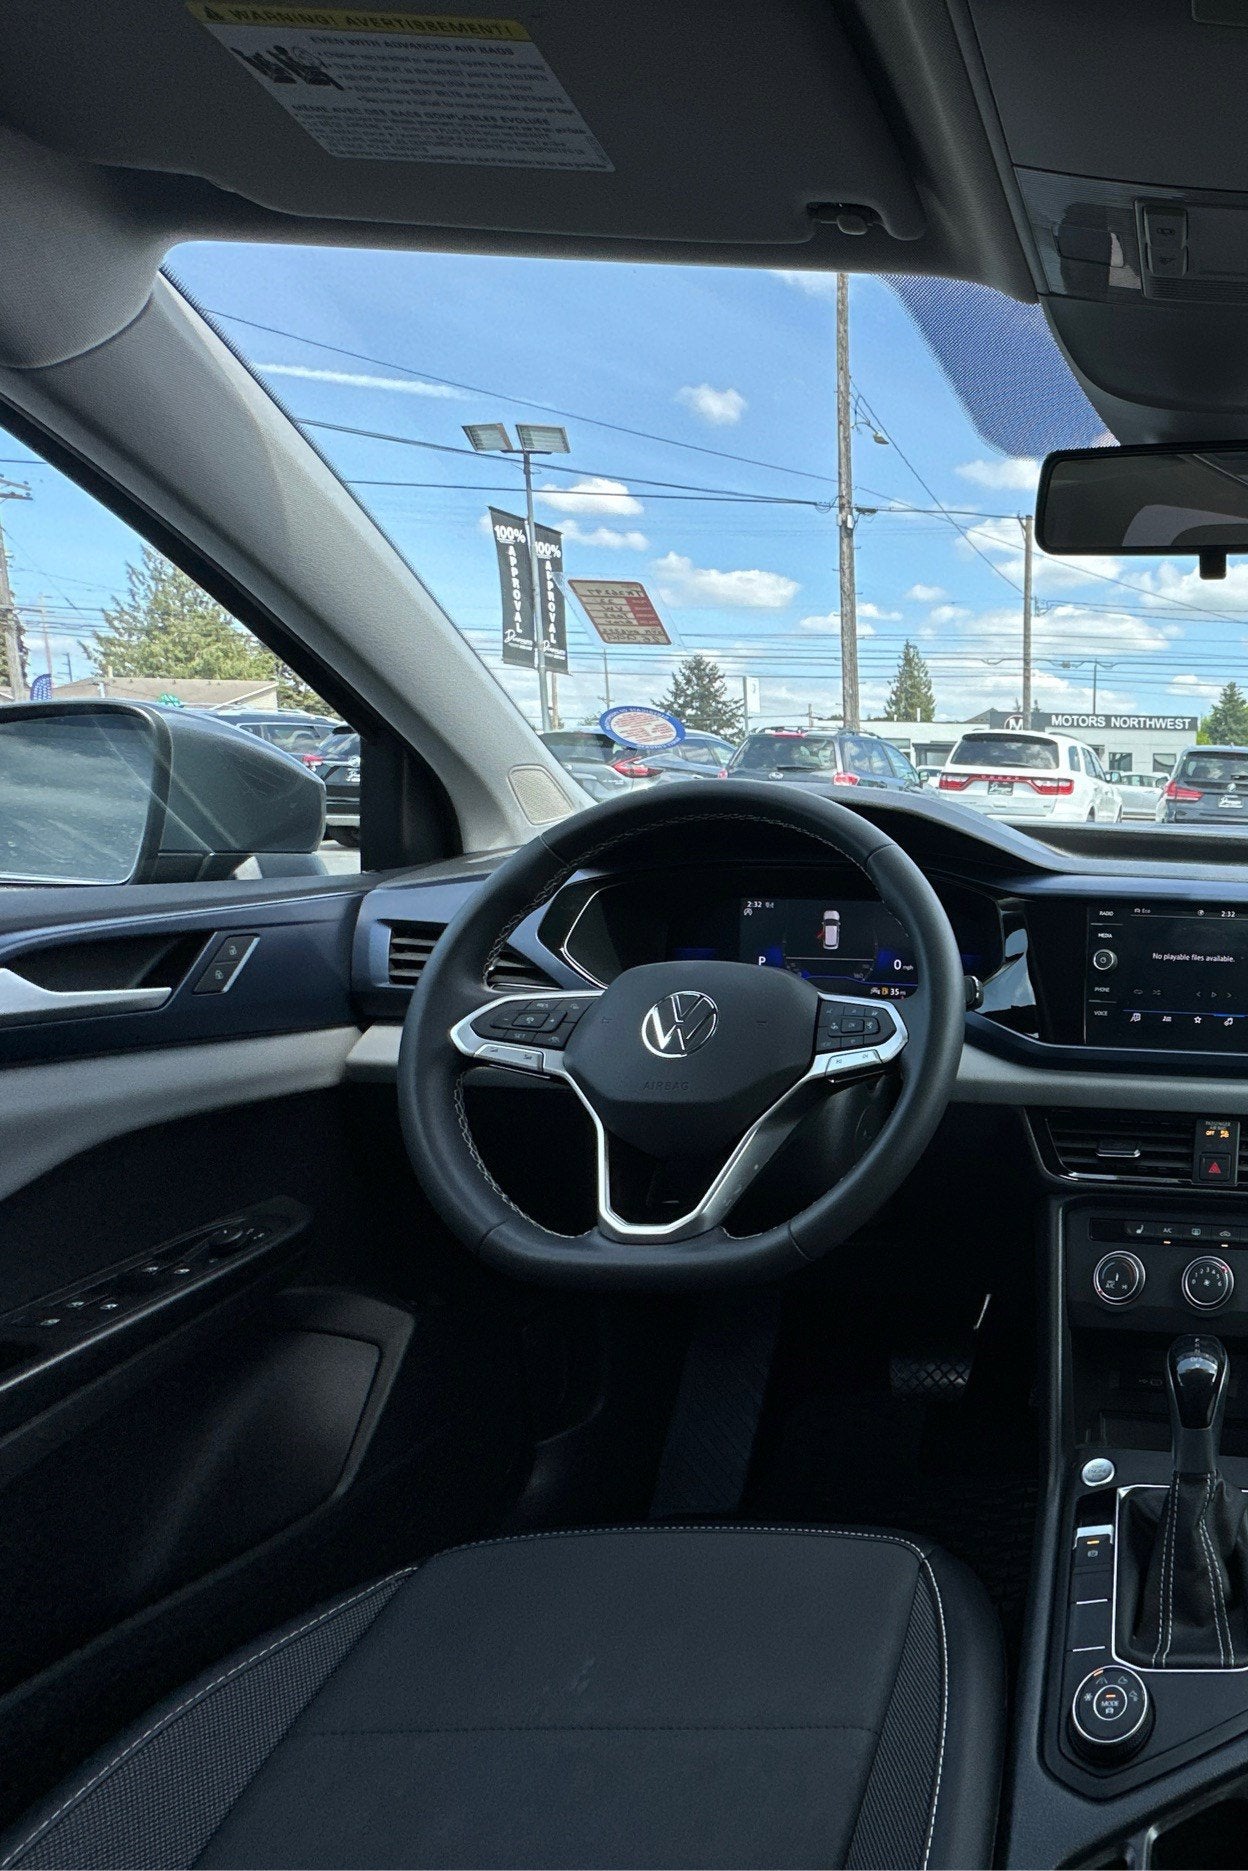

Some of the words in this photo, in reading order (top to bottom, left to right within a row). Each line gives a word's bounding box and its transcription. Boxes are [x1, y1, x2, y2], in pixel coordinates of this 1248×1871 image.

[230, 9, 336, 24] WARNING!
[494, 525, 526, 543] 100%
[534, 541, 562, 558] 100%
[508, 545, 523, 633] APPROVAL
[545, 560, 557, 644] APPROVAL
[1051, 715, 1105, 727] MOTORS
[1111, 716, 1191, 730] NORTHWEST
[758, 956, 766, 966] P
[893, 959, 901, 970] 0
[1152, 952, 1162, 960] No
[1163, 953, 1190, 962] playable
[1191, 953, 1204, 961] files
[1205, 955, 1235, 963] available.
[642, 1081, 689, 1090] AIRBAG
